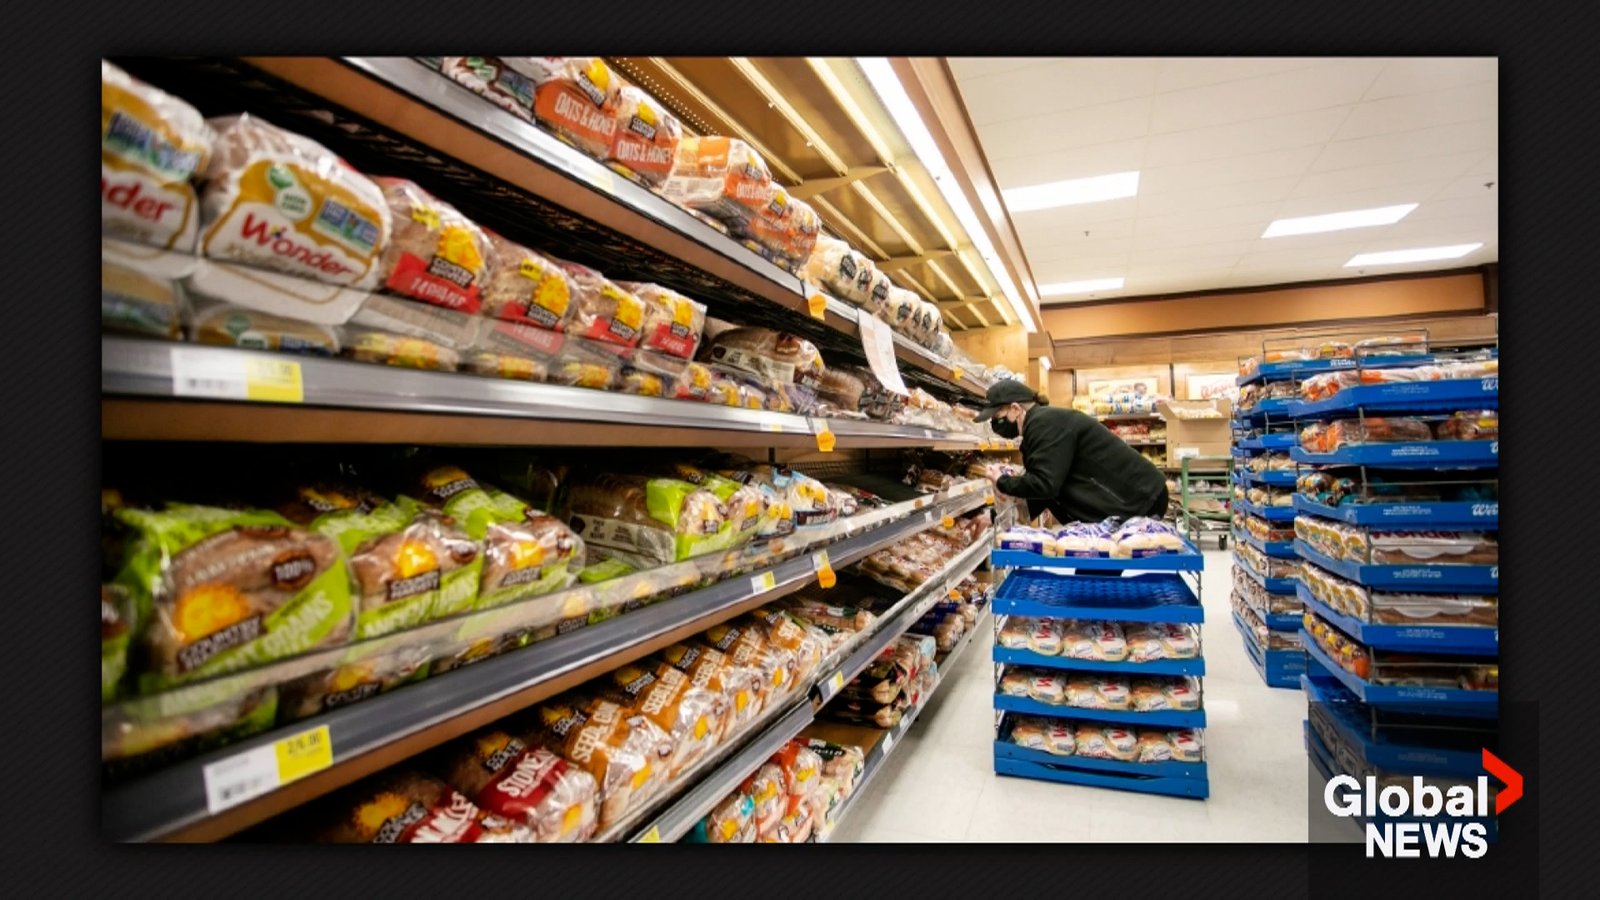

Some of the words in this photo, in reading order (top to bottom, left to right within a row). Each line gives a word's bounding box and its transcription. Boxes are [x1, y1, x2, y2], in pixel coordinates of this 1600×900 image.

[554, 91, 583, 122] OATS
[617, 140, 640, 162] OATS
[240, 212, 355, 276] Wonder
[571, 726, 600, 763] SEED
